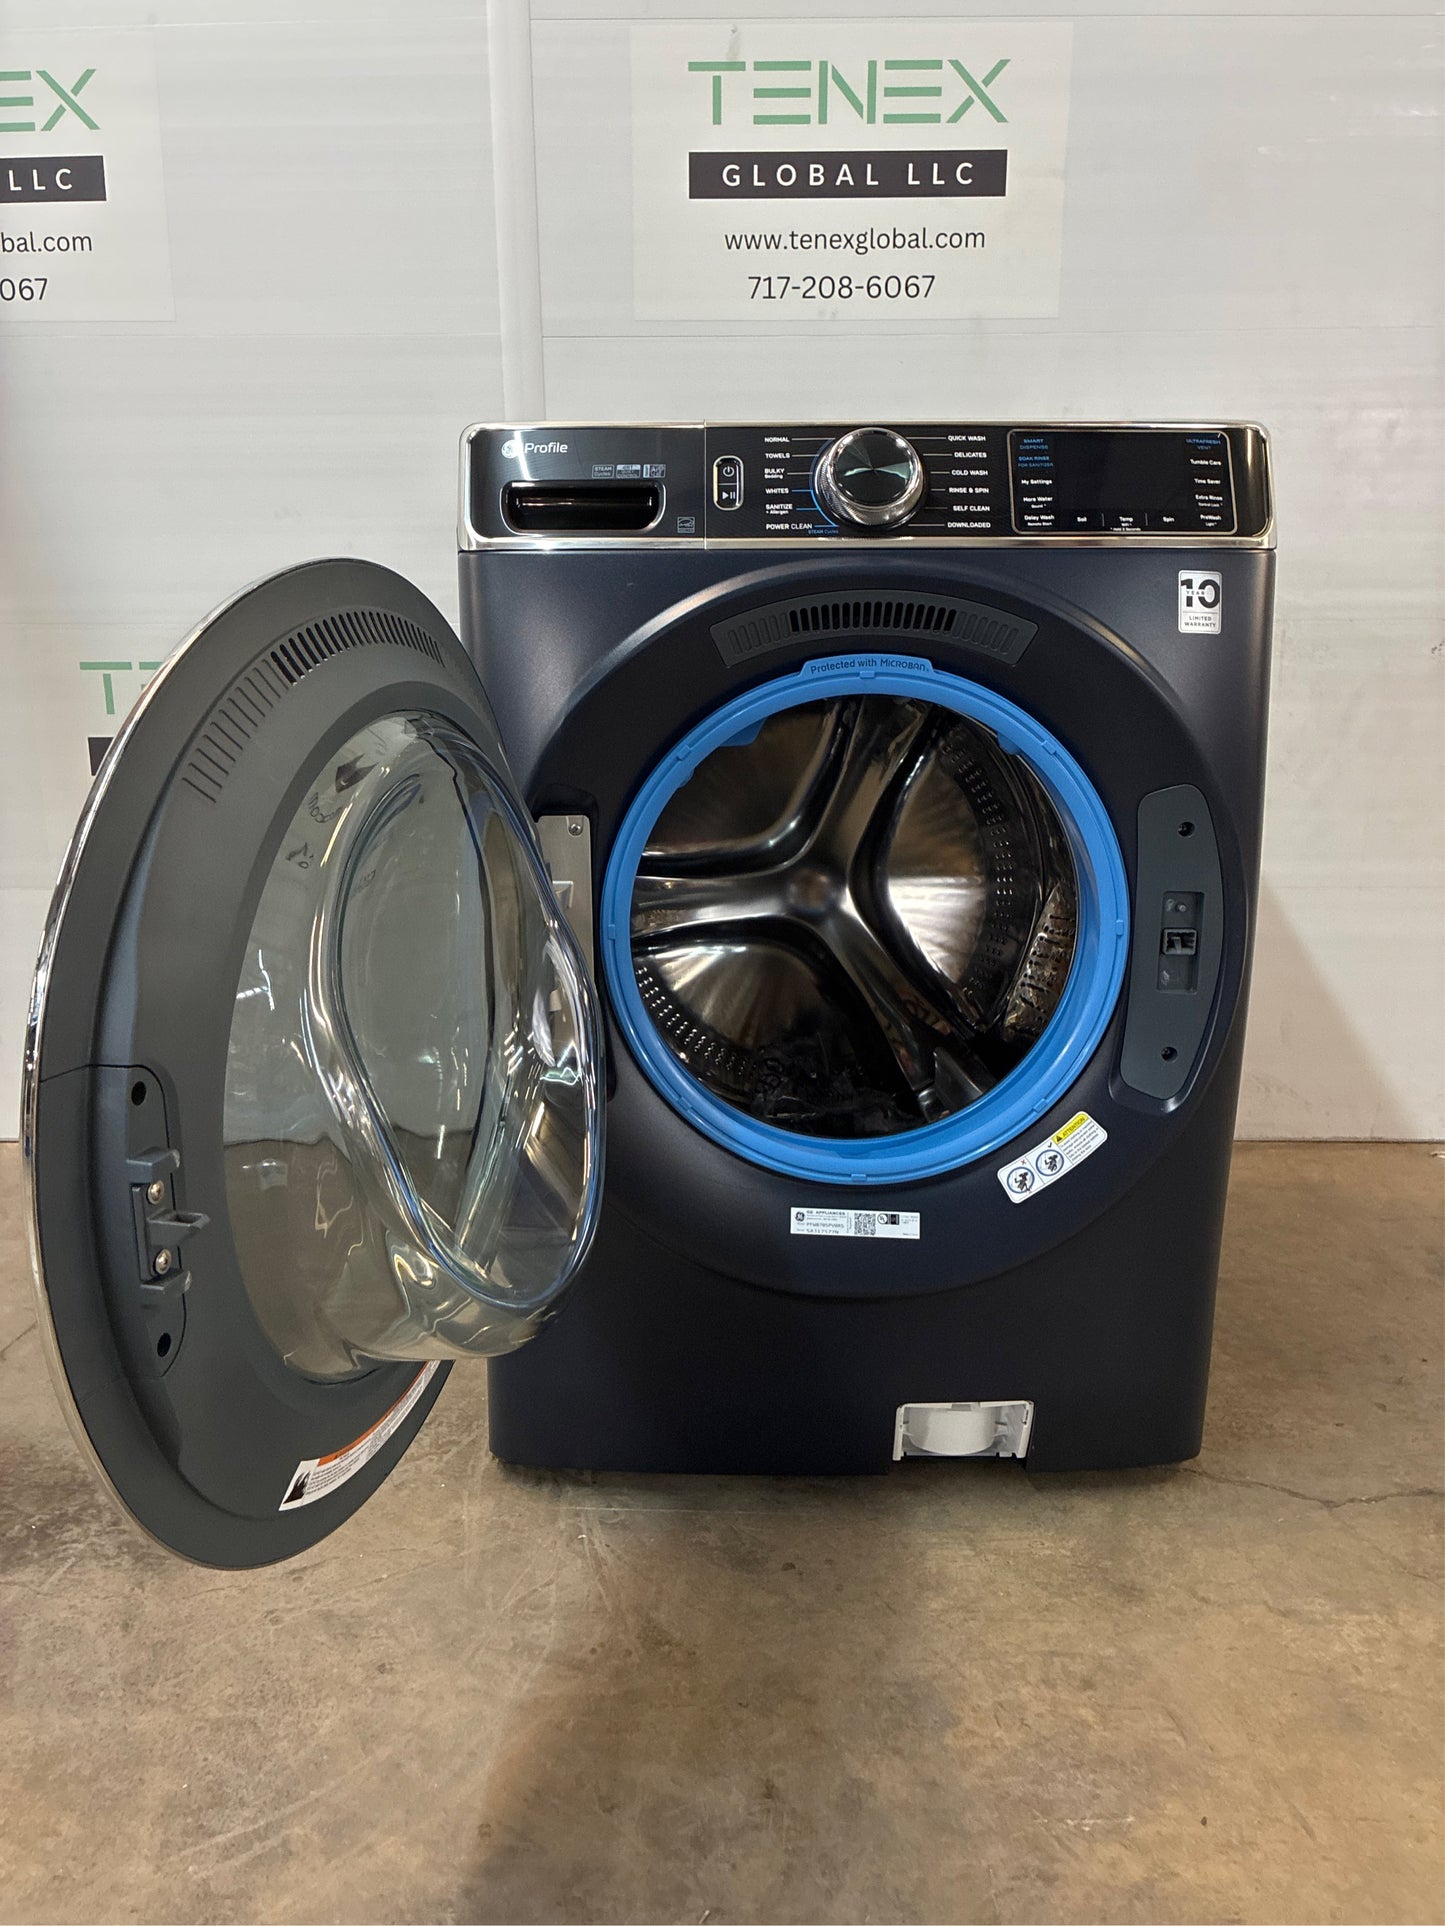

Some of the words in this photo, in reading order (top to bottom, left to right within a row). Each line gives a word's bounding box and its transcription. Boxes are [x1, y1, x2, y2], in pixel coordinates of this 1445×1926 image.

[688, 59, 1011, 125] TENEX
[8, 168, 72, 191] LLC
[722, 163, 879, 187] GLOBAL
[907, 162, 974, 185] LLC
[725, 228, 985, 254] www.tenexglobal.com
[748, 275, 935, 299] 717-208-6067
[524, 441, 568, 454] Profile
[1180, 578, 1221, 609] 10
[811, 660, 855, 674] Protected
[857, 658, 878, 668] with
